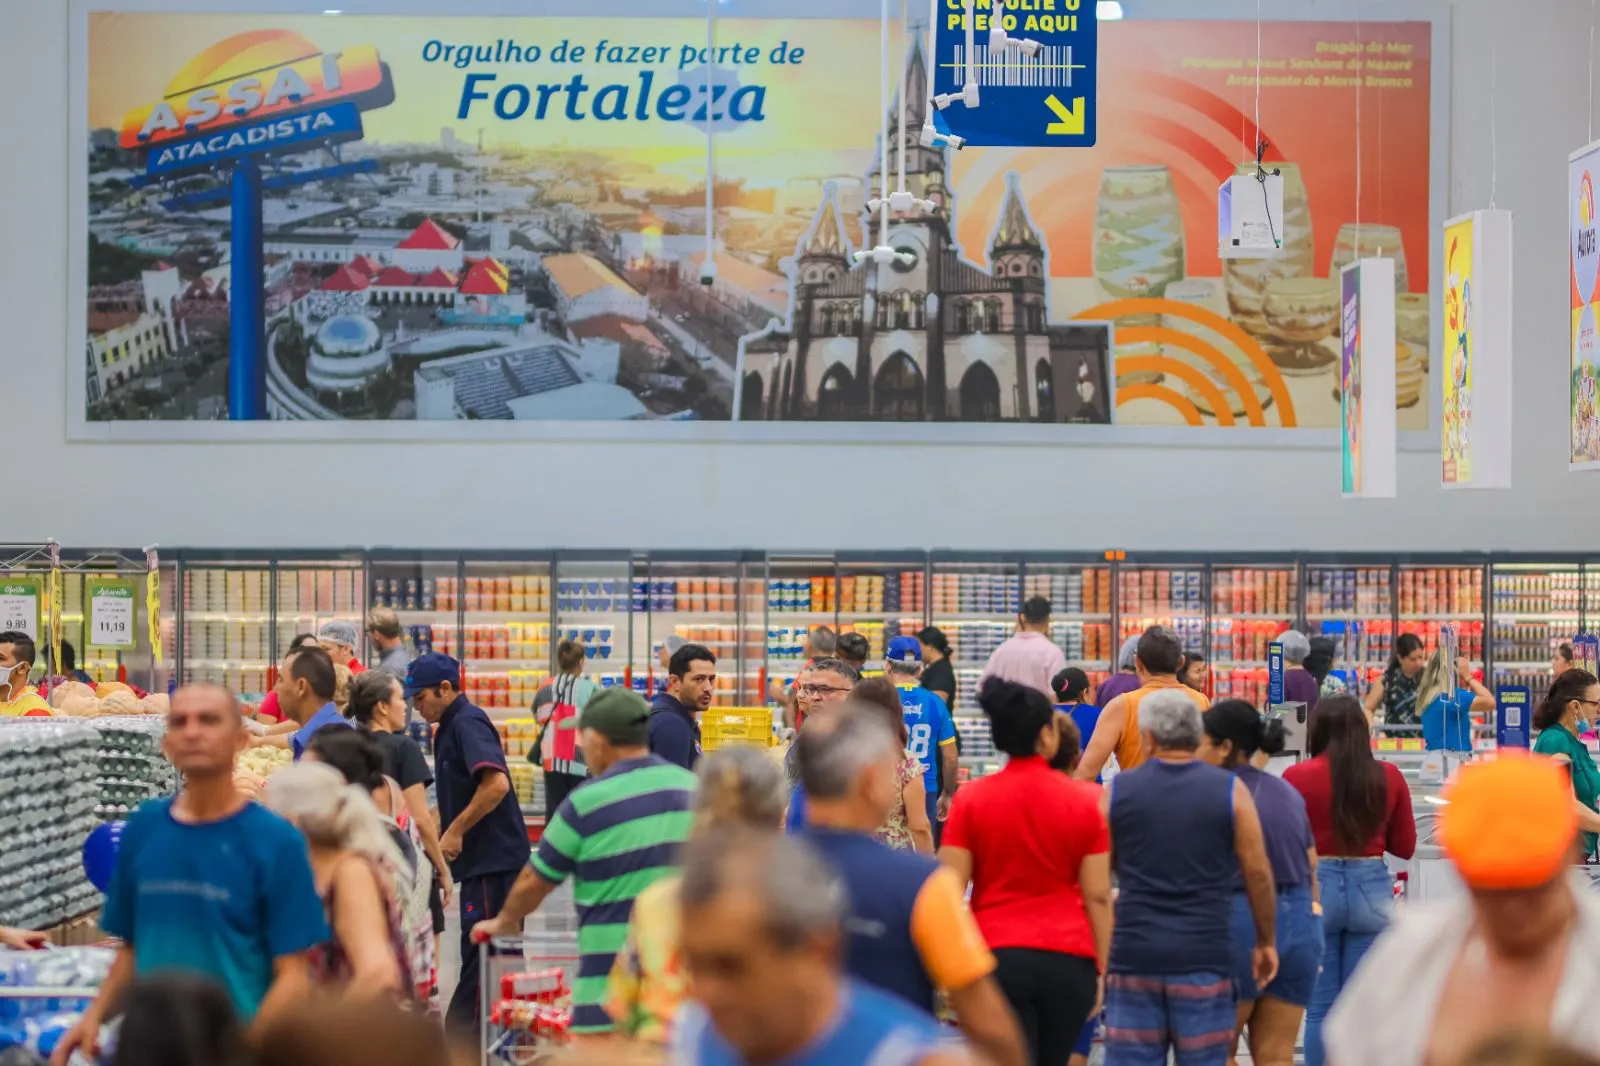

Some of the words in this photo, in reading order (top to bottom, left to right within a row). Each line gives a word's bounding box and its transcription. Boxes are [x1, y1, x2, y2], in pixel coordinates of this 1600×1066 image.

[1023, 14, 1078, 34] AQUI
[421, 39, 541, 68] Orgulho
[549, 40, 586, 64] de
[595, 40, 671, 64] fazer
[678, 43, 760, 69] parte
[769, 41, 806, 65] de
[1385, 42, 1413, 54] Mar
[1289, 57, 1344, 70] Senhora
[1226, 74, 1302, 87] Artesanato
[1364, 75, 1413, 88] Branco
[456, 70, 767, 122] Fortaleza
[156, 111, 334, 166] ATACADISTA
[6, 619, 27, 631] 9,89
[100, 621, 126, 633] 11,19
